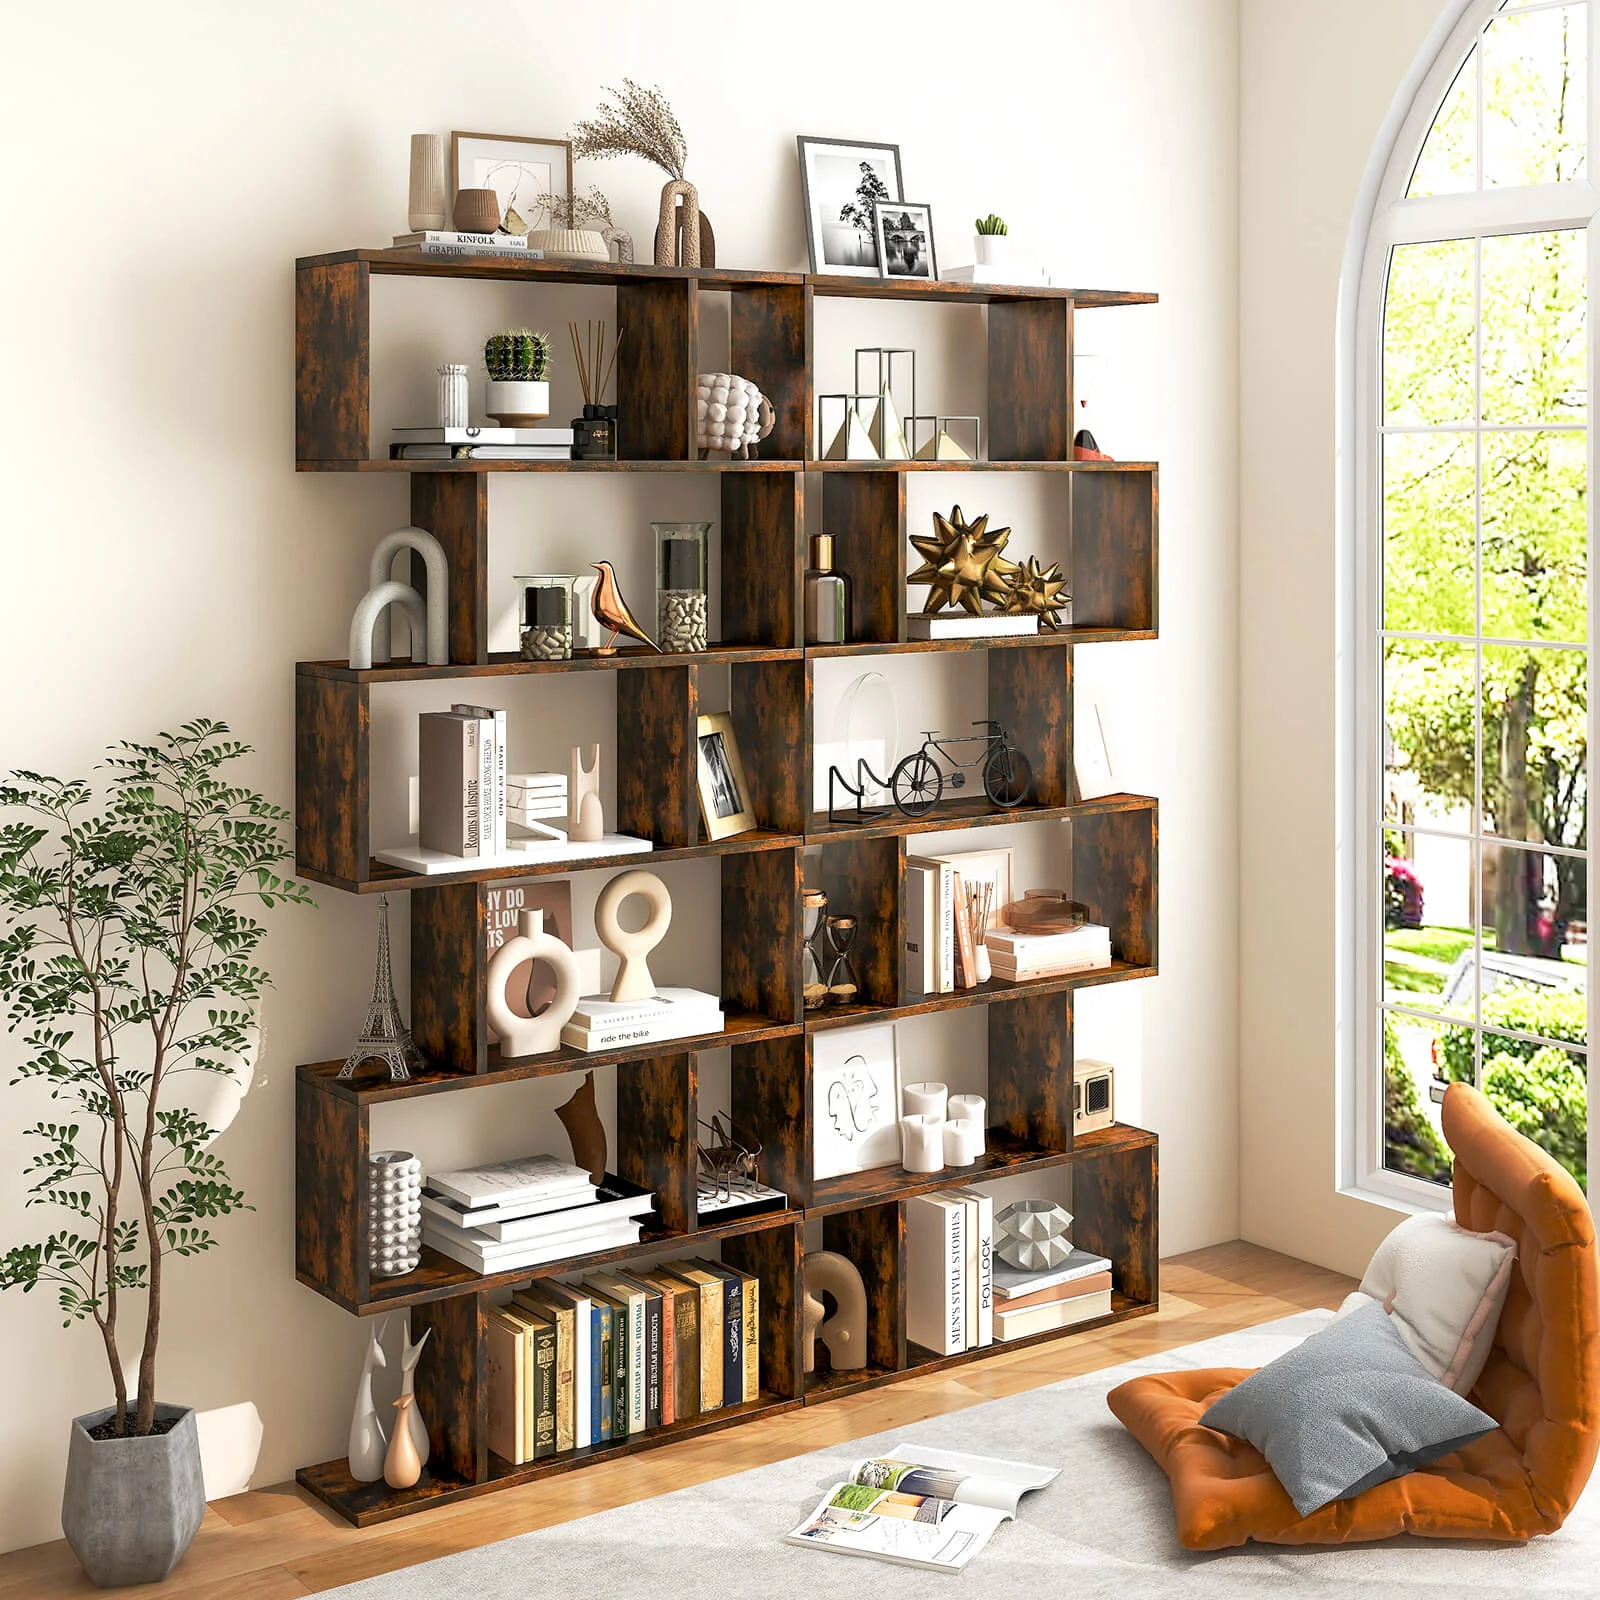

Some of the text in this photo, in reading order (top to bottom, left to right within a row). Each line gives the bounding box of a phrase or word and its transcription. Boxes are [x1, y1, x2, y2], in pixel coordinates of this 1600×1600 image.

[429, 245, 465, 256] GRAPHIC
[457, 235, 496, 245] KINFOLK
[483, 739, 492, 764] FRIENDS
[498, 776, 504, 788] BY
[464, 780, 479, 849] Rooms to Inspire
[487, 888, 525, 910] HY DO
[487, 909, 519, 930] E LOV
[487, 929, 504, 949] TS
[600, 1029, 650, 1043] ride the bike
[951, 1211, 961, 1344] MEN'S STYLE STORIES
[981, 1236, 991, 1309] POLLOCK
[650, 1312, 659, 1352] КРЕПОСТЬ
[634, 1303, 643, 1421] АЛЕКСАНДР БЛОК ПОЭМЫ
[650, 1353, 659, 1384] ЛЕСНАЯ
